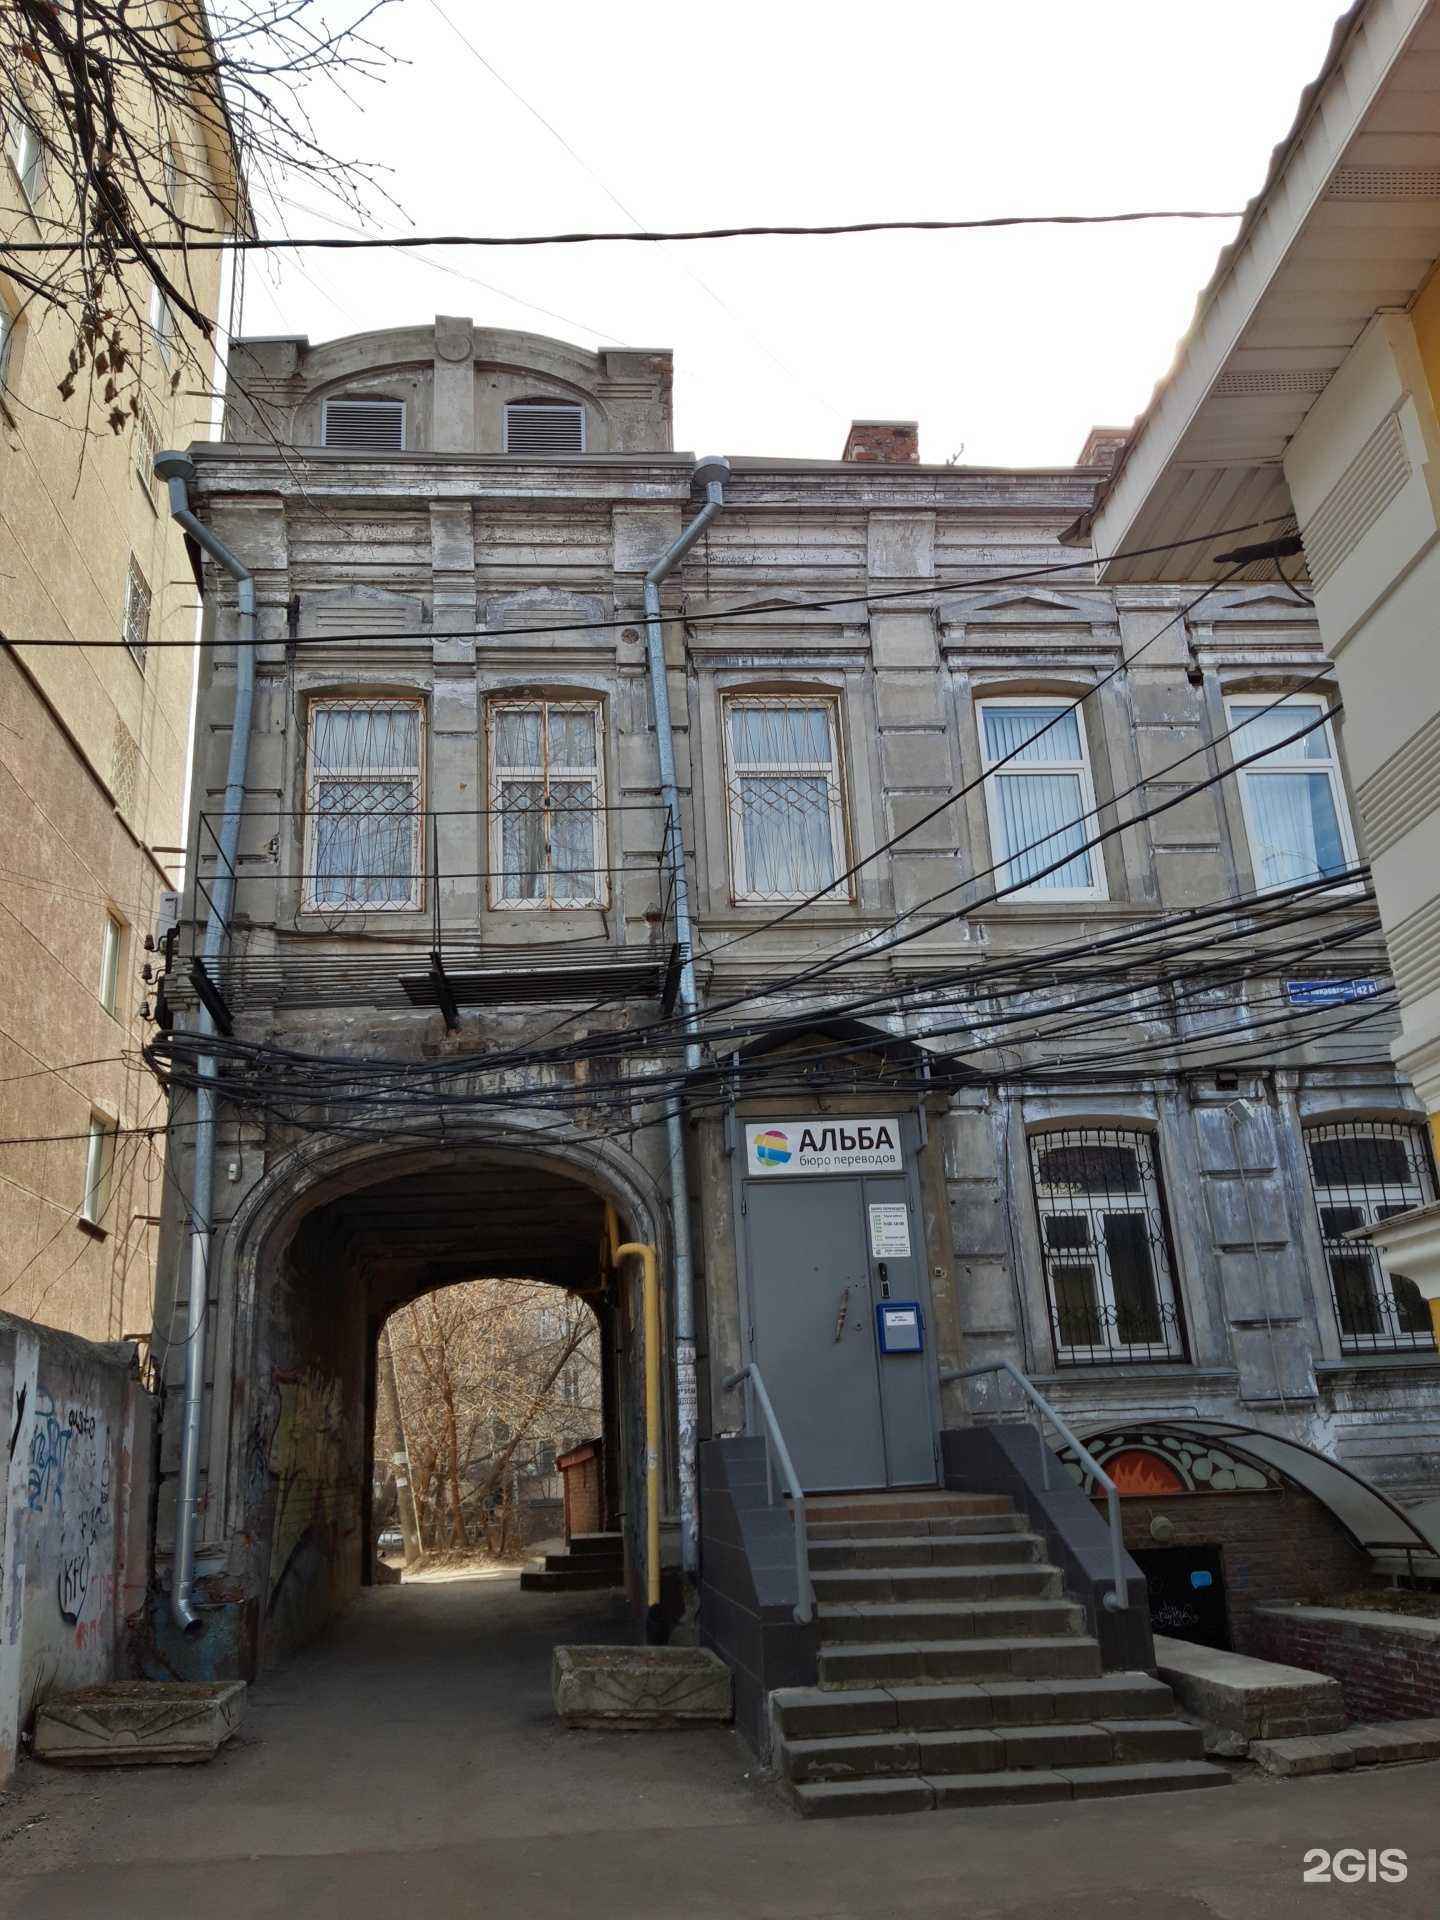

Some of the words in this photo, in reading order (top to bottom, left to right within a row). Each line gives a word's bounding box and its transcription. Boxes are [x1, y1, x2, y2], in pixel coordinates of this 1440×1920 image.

[799, 1126, 895, 1152] АЛЬБА
[800, 1155, 831, 1167] бюро
[834, 1154, 896, 1167] переводов
